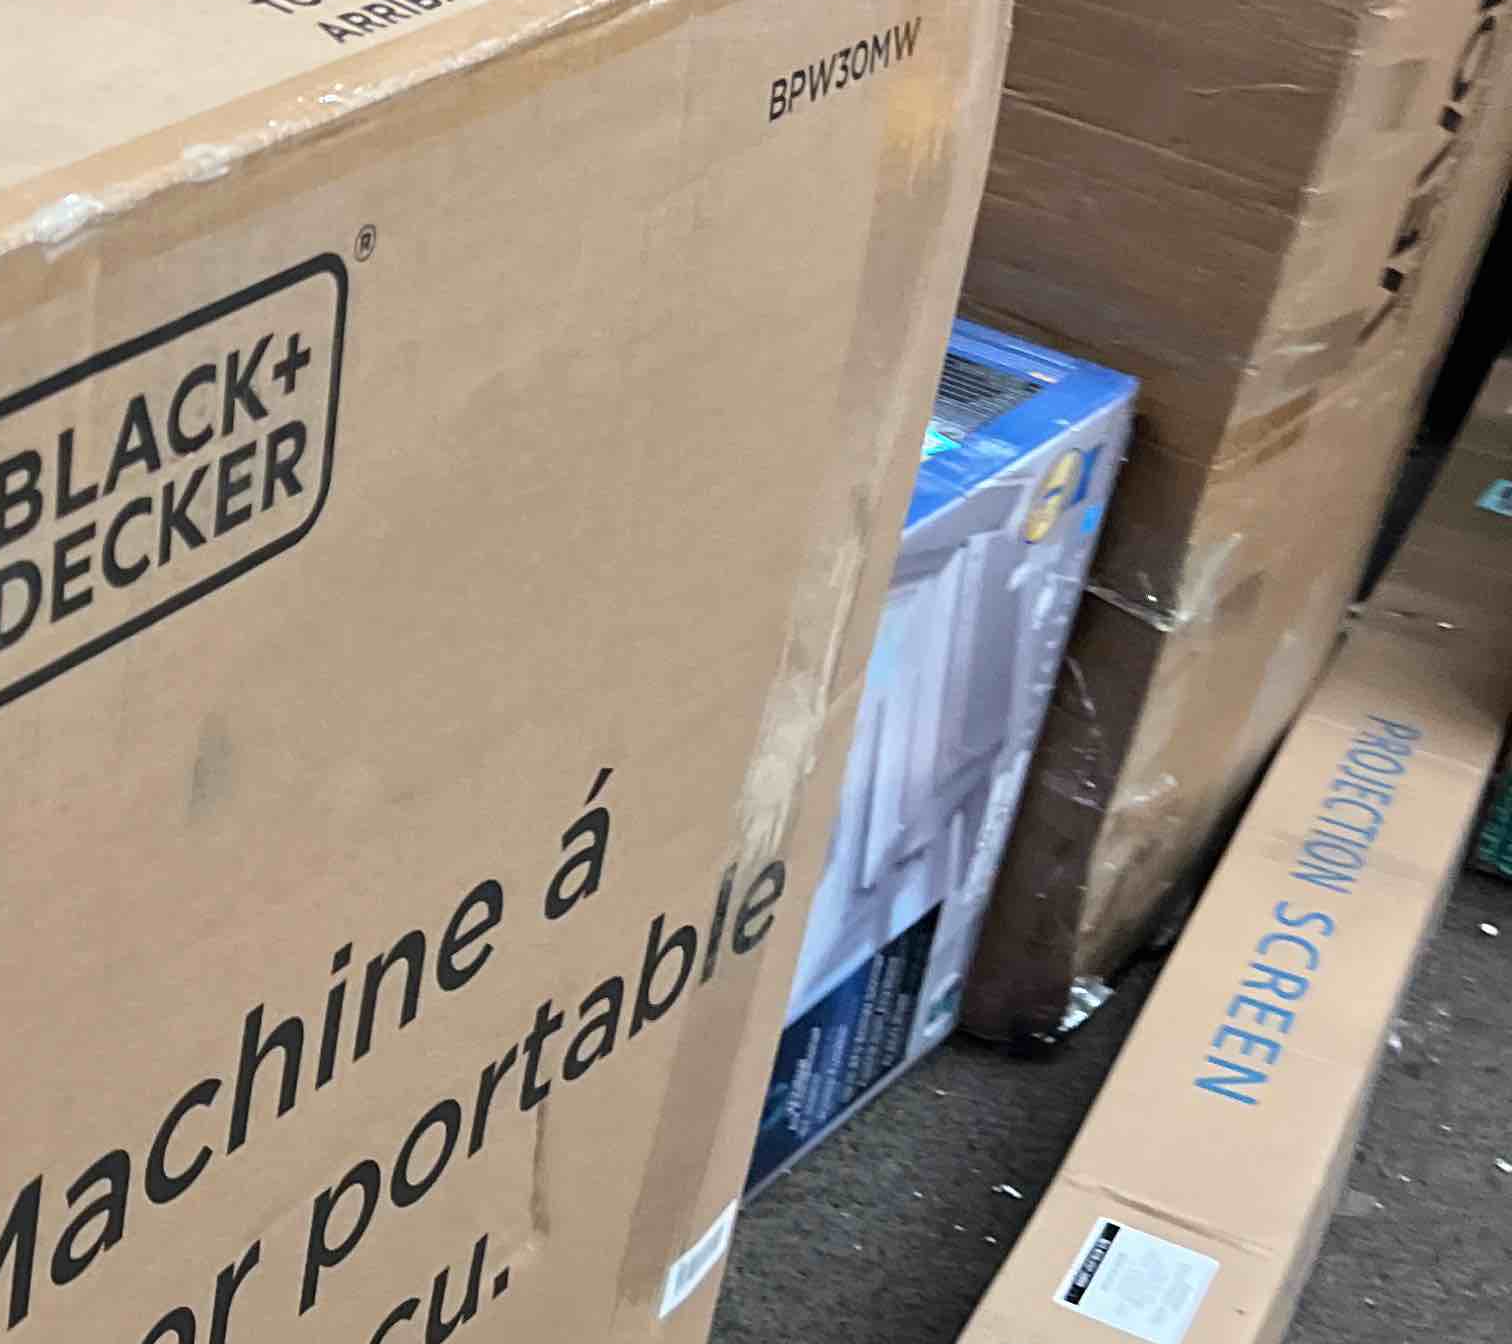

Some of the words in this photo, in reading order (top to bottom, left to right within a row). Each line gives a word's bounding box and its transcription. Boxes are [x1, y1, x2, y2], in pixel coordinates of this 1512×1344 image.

[768, 16, 923, 123] BPW30MW
[543, 767, 613, 922] á
[1287, 714, 1425, 895] PROJECTION
[299, 856, 786, 1317] portable
[1193, 900, 1338, 1106] SCREEN
